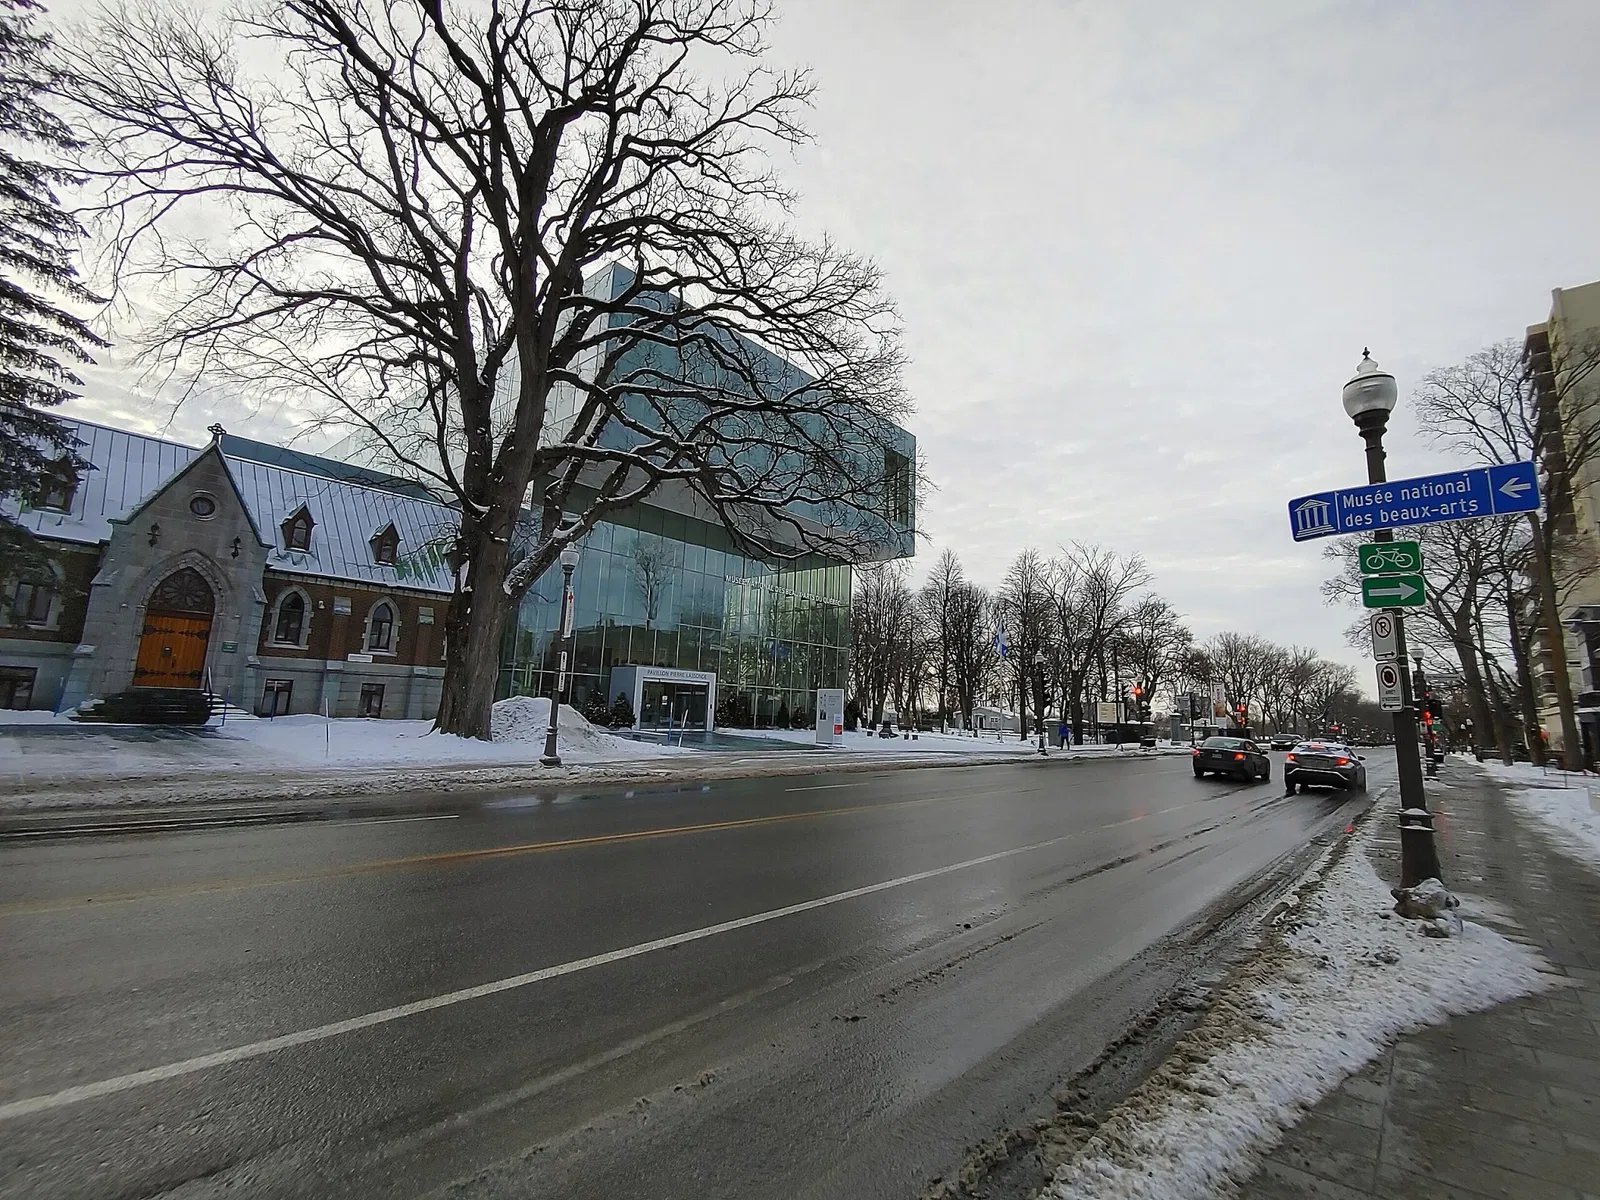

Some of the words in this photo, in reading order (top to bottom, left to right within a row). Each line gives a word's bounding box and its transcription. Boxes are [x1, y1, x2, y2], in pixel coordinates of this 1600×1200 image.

[1342, 489, 1393, 509] Musée
[1400, 477, 1472, 501] national
[1345, 513, 1373, 527] des
[1380, 499, 1479, 523] beaux-arts
[647, 669, 669, 677] PAVILLON
